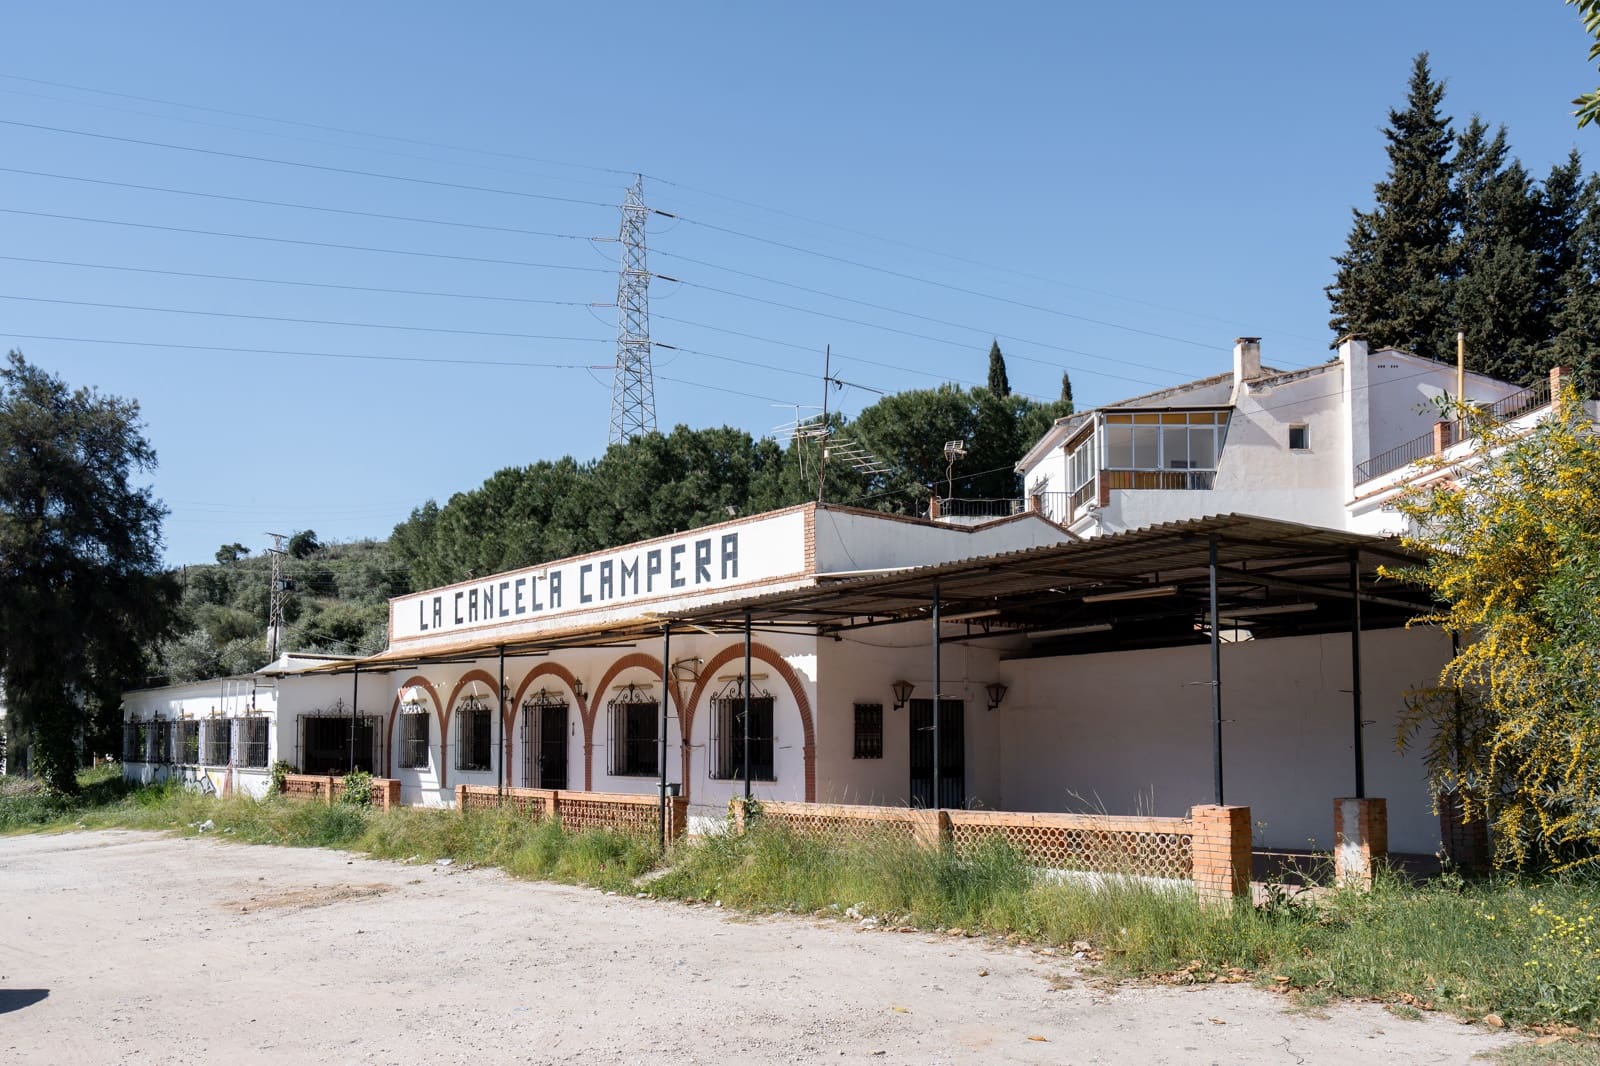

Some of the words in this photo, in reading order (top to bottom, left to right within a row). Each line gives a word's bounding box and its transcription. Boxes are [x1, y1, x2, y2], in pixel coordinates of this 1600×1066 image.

[420, 597, 441, 630] LA
[455, 571, 562, 625] CANCELA
[580, 533, 739, 603] CAMPERA
